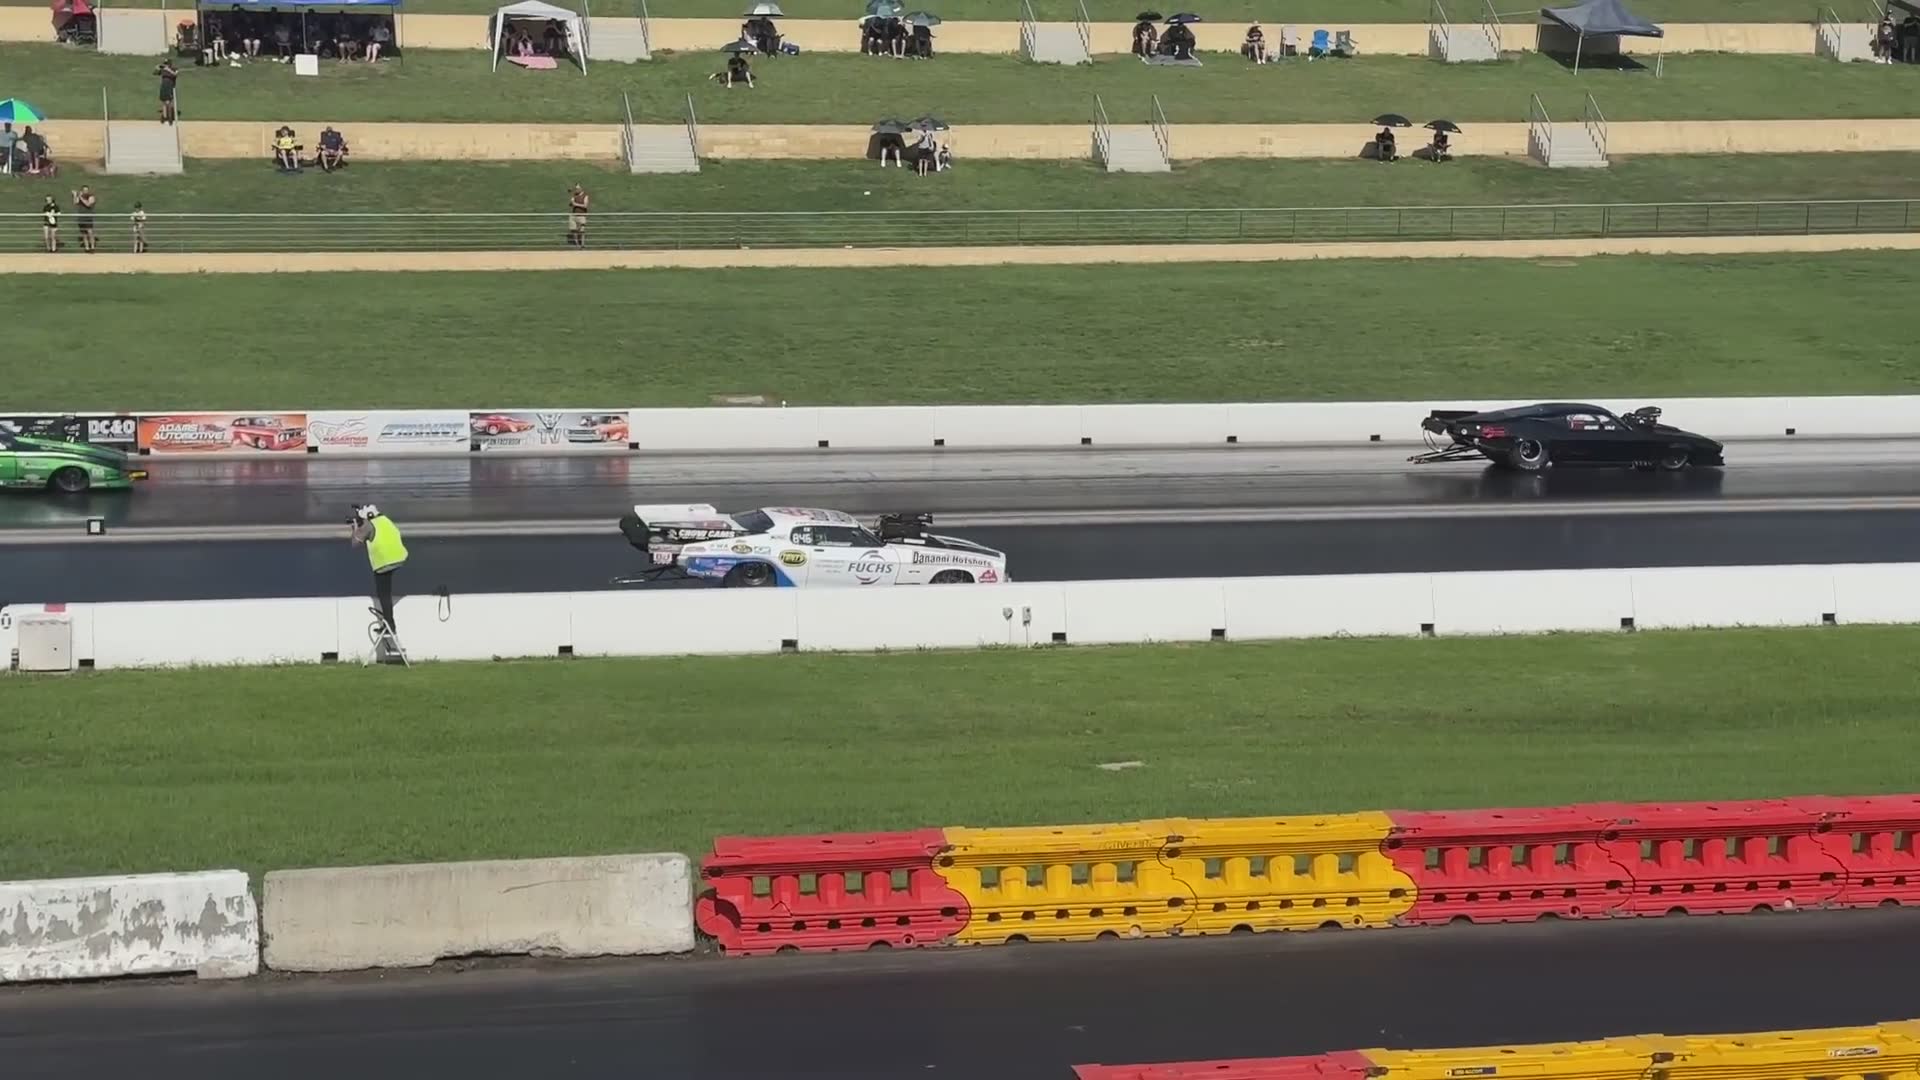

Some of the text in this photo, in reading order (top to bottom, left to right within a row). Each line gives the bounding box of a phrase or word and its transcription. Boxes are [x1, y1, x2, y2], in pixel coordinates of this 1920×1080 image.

[88, 420, 135, 434] DC&O
[159, 424, 198, 432] ADAMS
[152, 431, 224, 440] AUTOMOTIVE
[708, 530, 735, 538] CAMS
[912, 551, 992, 567] Dananni Hotshots
[848, 562, 893, 573] FUCHS
